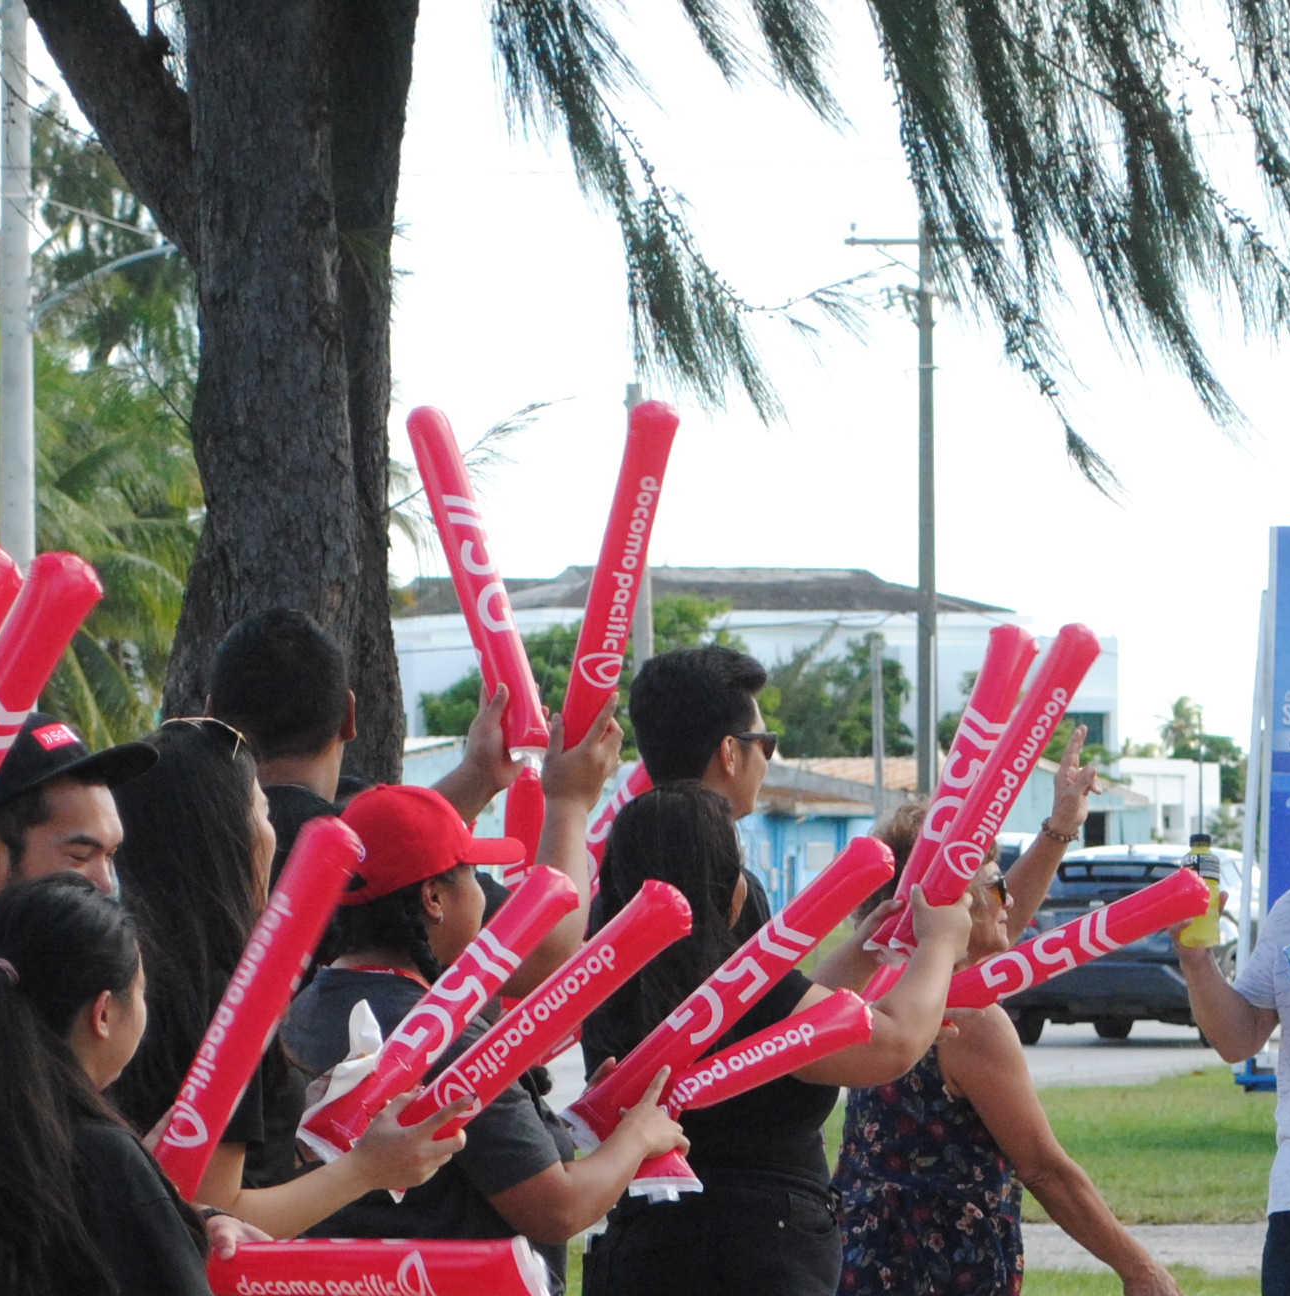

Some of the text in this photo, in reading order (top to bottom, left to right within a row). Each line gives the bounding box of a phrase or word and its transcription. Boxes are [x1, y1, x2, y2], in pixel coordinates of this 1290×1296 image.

[602, 476, 659, 651] docomo pacific
[923, 750, 985, 842] 5G
[972, 687, 1067, 846] docomo pacific
[182, 890, 293, 1101] docomo pacific
[391, 963, 489, 1065] 5G
[465, 944, 616, 1085] docomo pacific
[666, 955, 770, 1045] 5G
[980, 929, 1077, 1000] 5G
[668, 1022, 815, 1111] docomo pacifi
